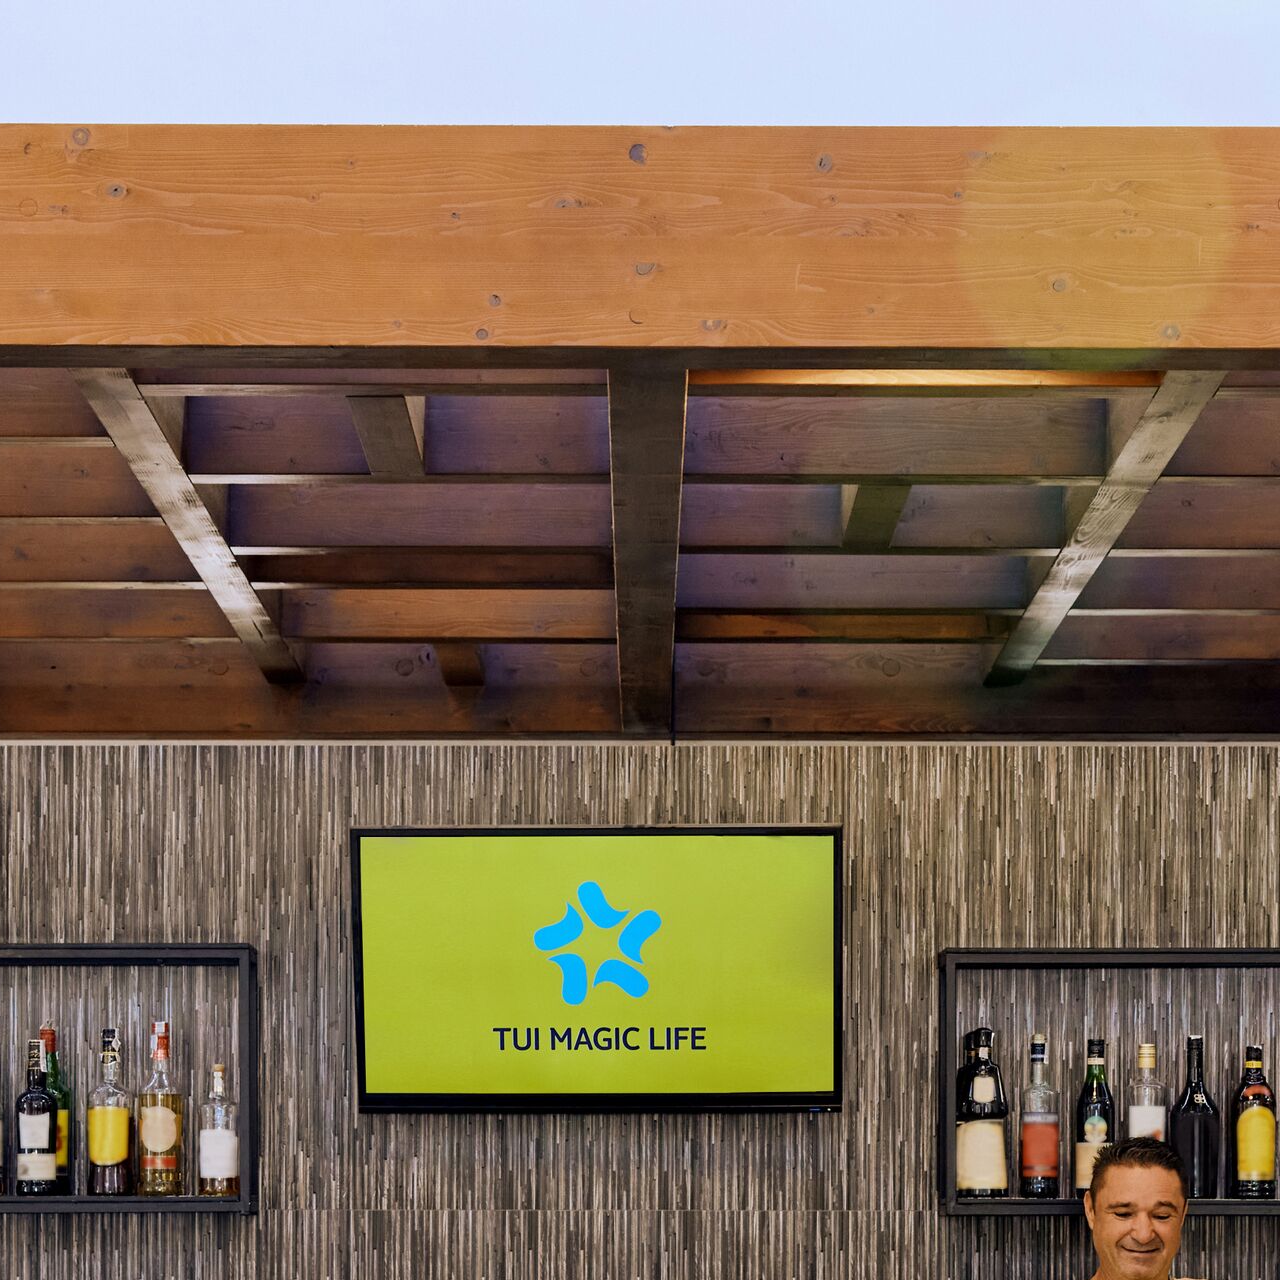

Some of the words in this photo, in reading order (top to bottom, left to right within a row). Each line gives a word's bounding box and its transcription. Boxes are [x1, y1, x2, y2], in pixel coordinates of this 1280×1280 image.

[493, 1027, 540, 1051] TUI
[549, 1026, 641, 1051] MAGIC
[649, 1026, 707, 1051] LIFE
